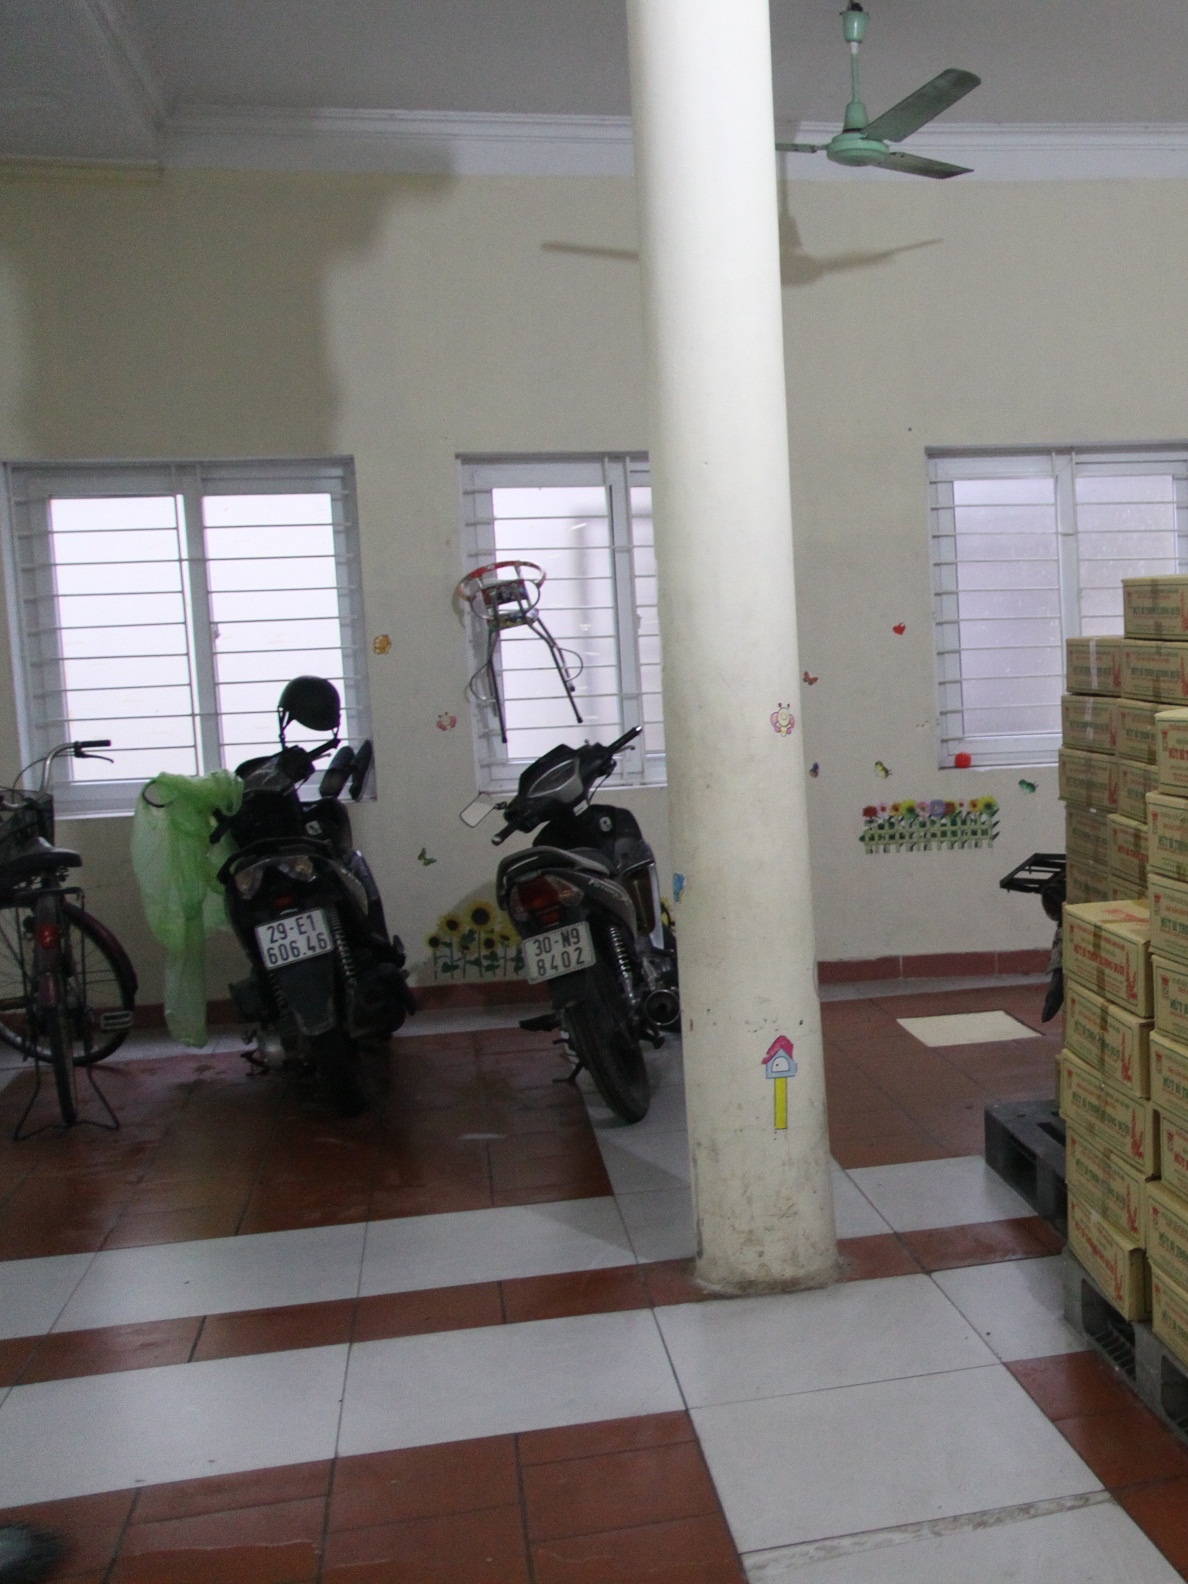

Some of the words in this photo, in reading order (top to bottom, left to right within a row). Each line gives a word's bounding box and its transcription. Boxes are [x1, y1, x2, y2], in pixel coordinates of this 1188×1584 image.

[267, 913, 316, 944] 29-E1
[267, 932, 328, 965] 606.46
[536, 947, 585, 977] 8402
